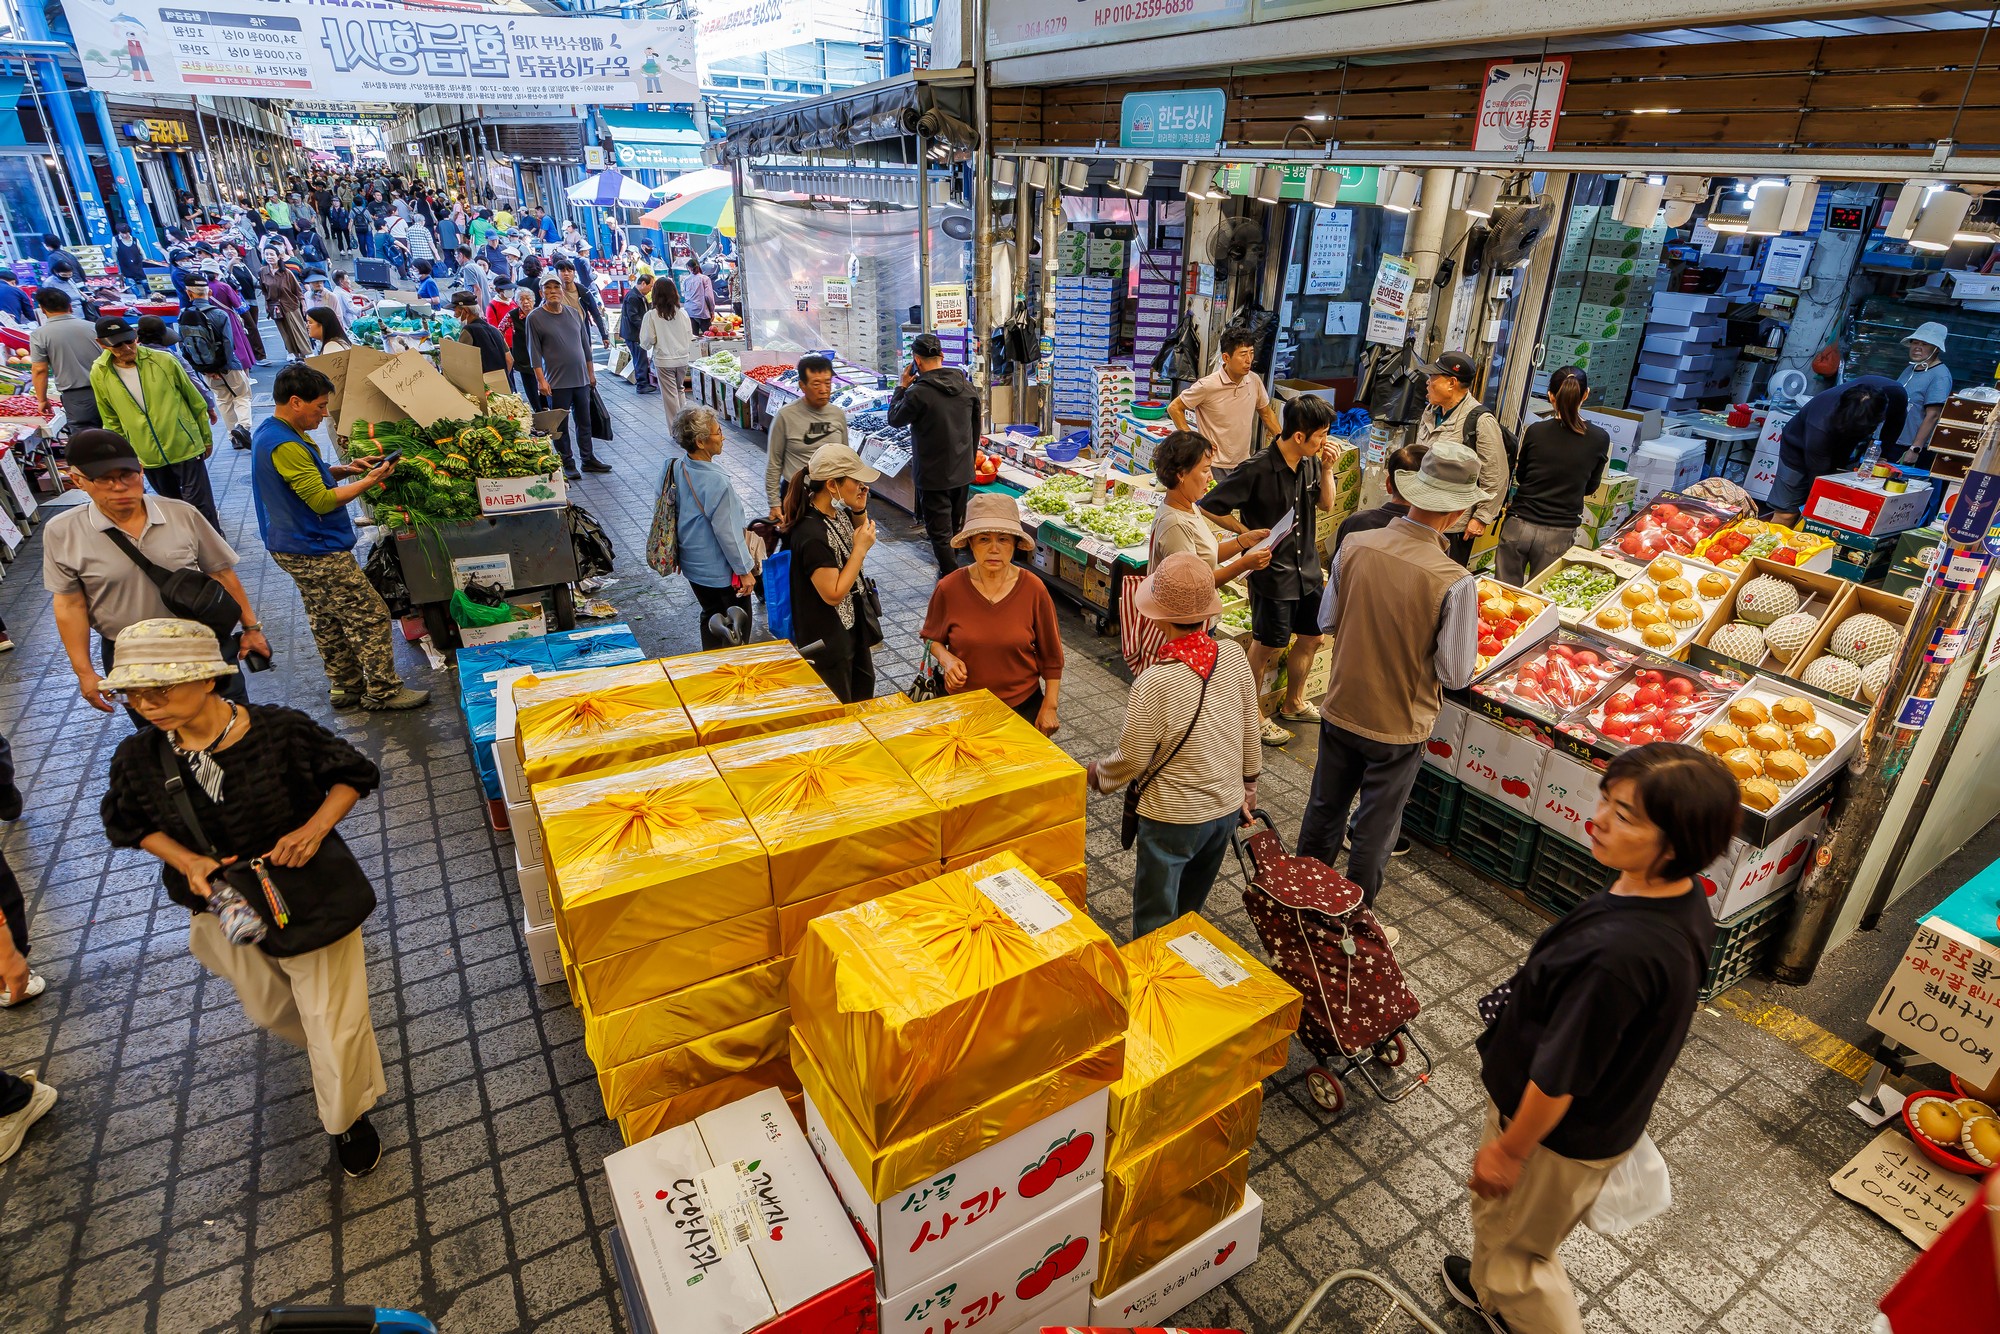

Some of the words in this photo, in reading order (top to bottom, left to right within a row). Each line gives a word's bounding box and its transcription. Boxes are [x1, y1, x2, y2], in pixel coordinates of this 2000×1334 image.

[1095, 6, 1111, 27] H.P
[1158, 104, 1213, 131] 한도상사
[1482, 111, 1515, 127] CCTV
[1514, 109, 1552, 128] 작동중
[1330, 211, 1337, 221] 9
[1380, 272, 1409, 292] 환급행사
[827, 293, 848, 301] 참여점포
[1377, 285, 1404, 303] 참여점포
[936, 299, 962, 310] 환급행사
[936, 309, 963, 320] 참여점포
[808, 422, 832, 434] NIKE
[494, 493, 527, 506] 시금치
[1952, 564, 1976, 574] 제로페이
[1482, 702, 1504, 717] 사과
[1467, 743, 1485, 758] 산골
[1568, 742, 1591, 758] 사과
[1466, 759, 1497, 782] 사과
[1546, 783, 1567, 798] 산골
[1545, 799, 1581, 823] 사과
[1739, 861, 1775, 890] 사과
[1914, 928, 1940, 957] 햇
[1941, 940, 1972, 971] 홍로
[1923, 981, 1994, 1029] 한바구니
[900, 1172, 957, 1213] 산골
[1874, 1161, 1954, 1220] 한바구니
[665, 1178, 722, 1275] 단양사과
[909, 1186, 1007, 1253] 사과
[904, 1283, 958, 1322] 산골
